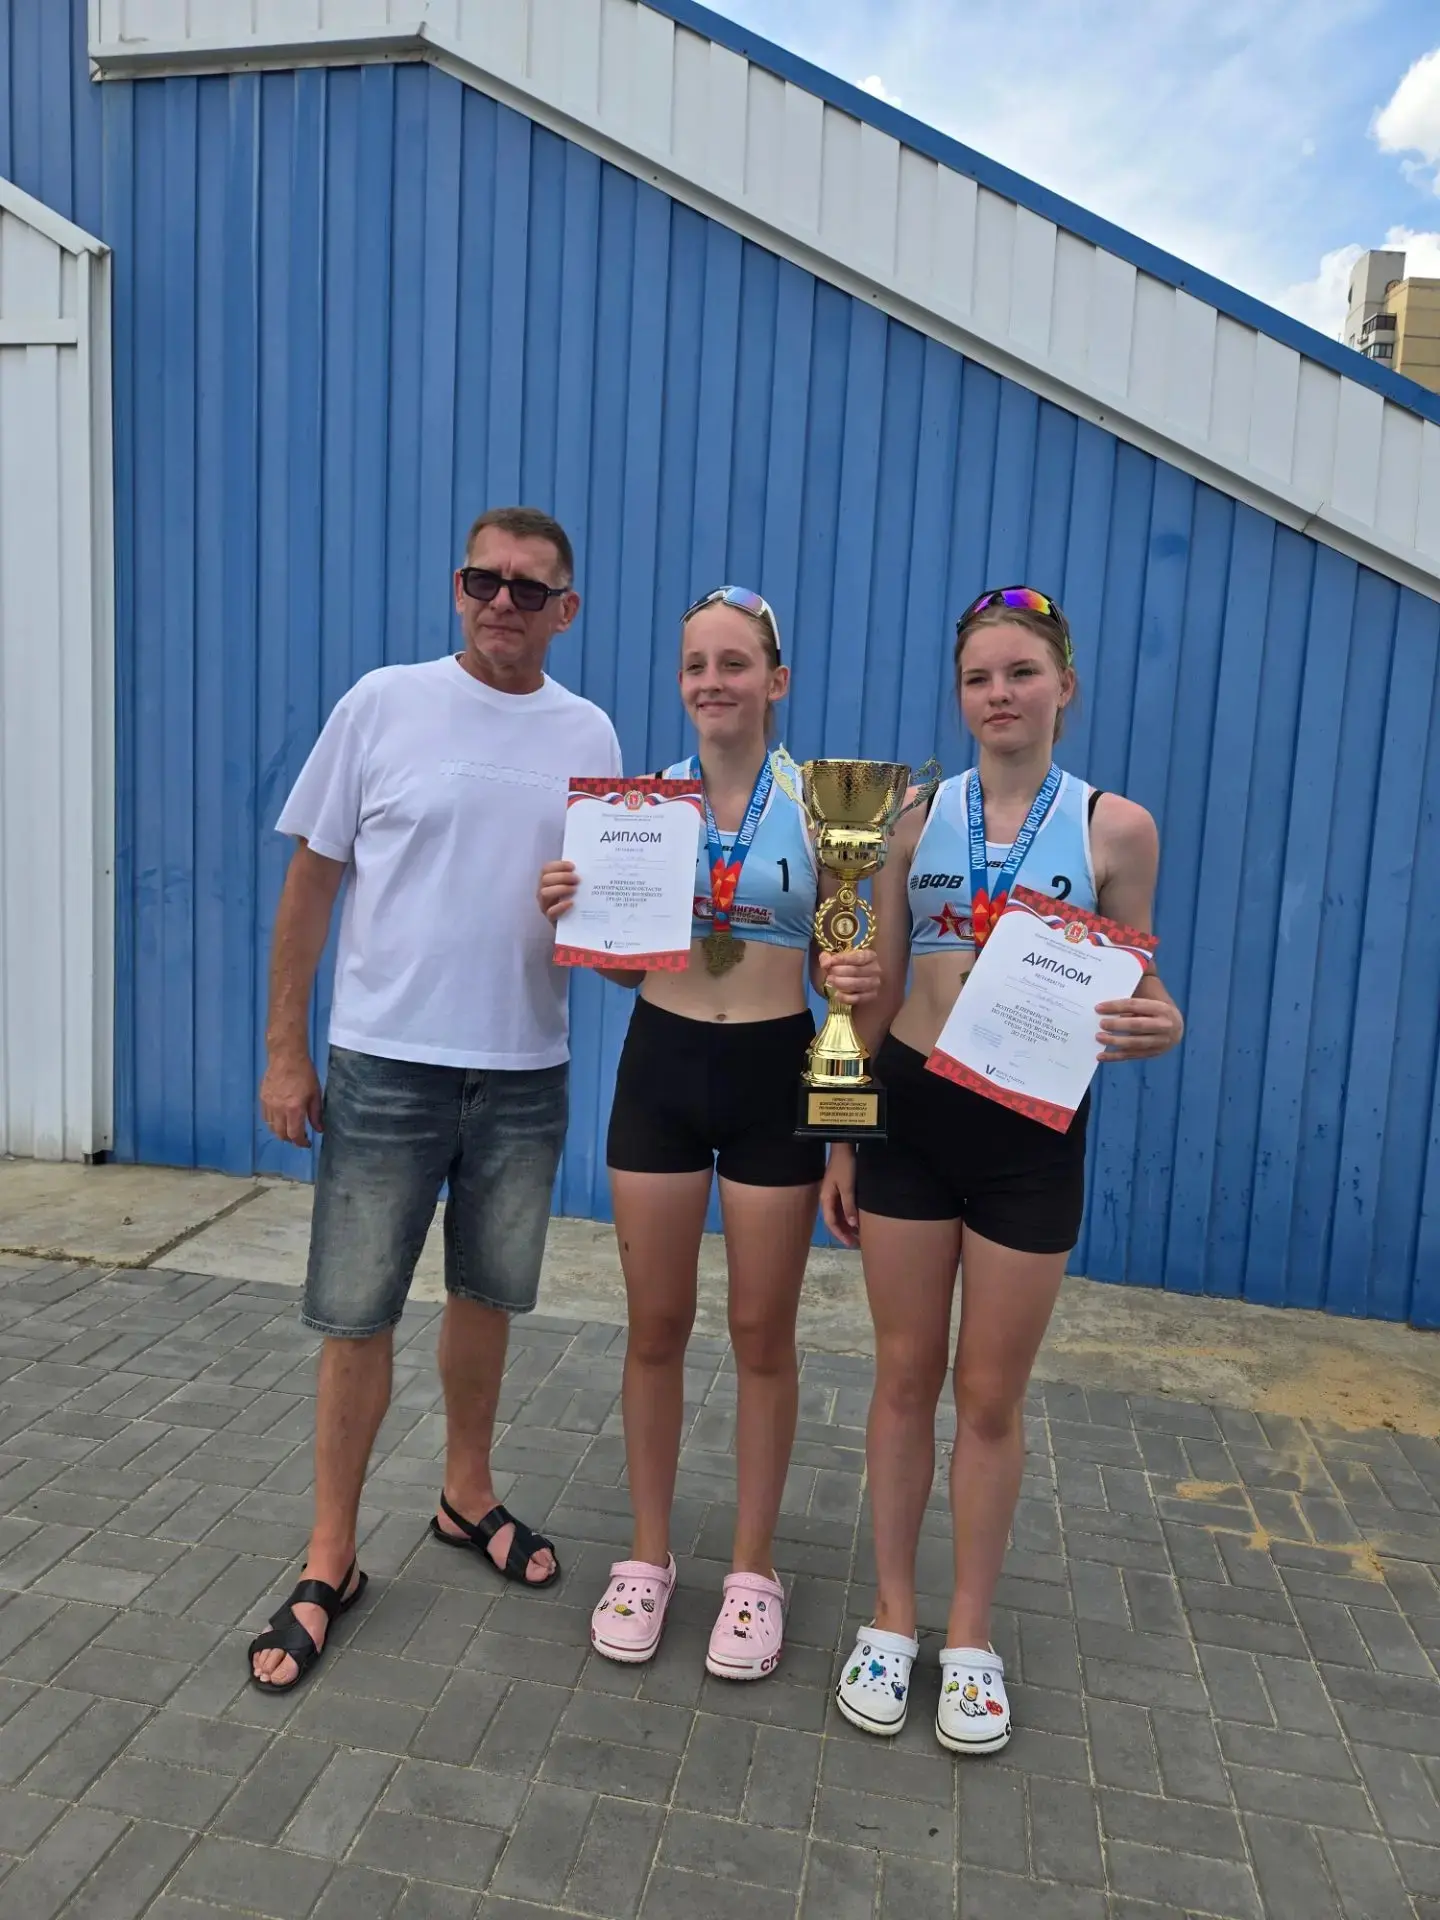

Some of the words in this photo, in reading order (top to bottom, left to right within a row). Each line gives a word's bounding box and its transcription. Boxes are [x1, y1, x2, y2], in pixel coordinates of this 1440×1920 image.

[1021, 763, 1062, 832] ОЛГОГРАДСКОЙ
[600, 830, 662, 844] ДИПЛОМ
[737, 804, 764, 846] КОМИТЕТ
[970, 829, 986, 870] КОМИТЕТ
[1001, 829, 1033, 875] ОБЛАСТИ
[776, 857, 789, 893] 1
[918, 873, 964, 890] ВФВ
[1051, 875, 1072, 901] 2
[1022, 951, 1092, 986] ДИПЛОМ
